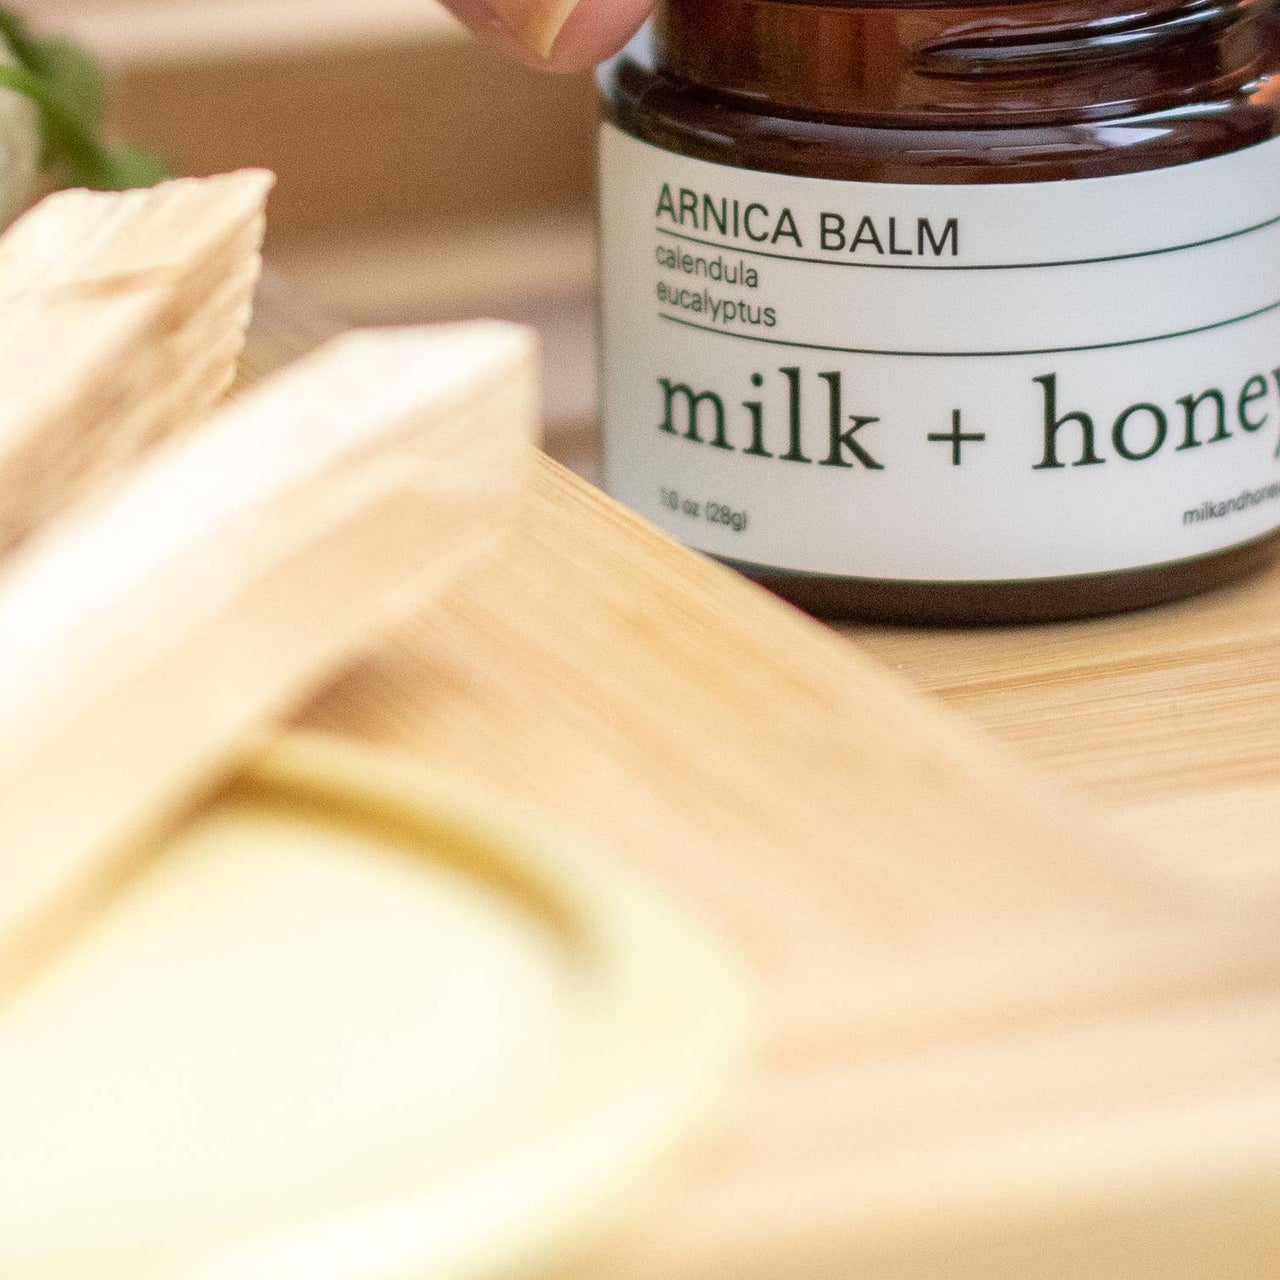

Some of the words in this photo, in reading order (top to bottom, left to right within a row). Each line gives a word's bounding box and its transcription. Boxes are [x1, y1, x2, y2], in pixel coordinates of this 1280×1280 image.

[655, 182, 803, 249] ARNICA
[819, 213, 961, 257] BALM
[655, 243, 760, 289] calendula
[656, 280, 778, 328] eucalyptus
[658, 366, 886, 471] milk
[927, 408, 987, 466] +
